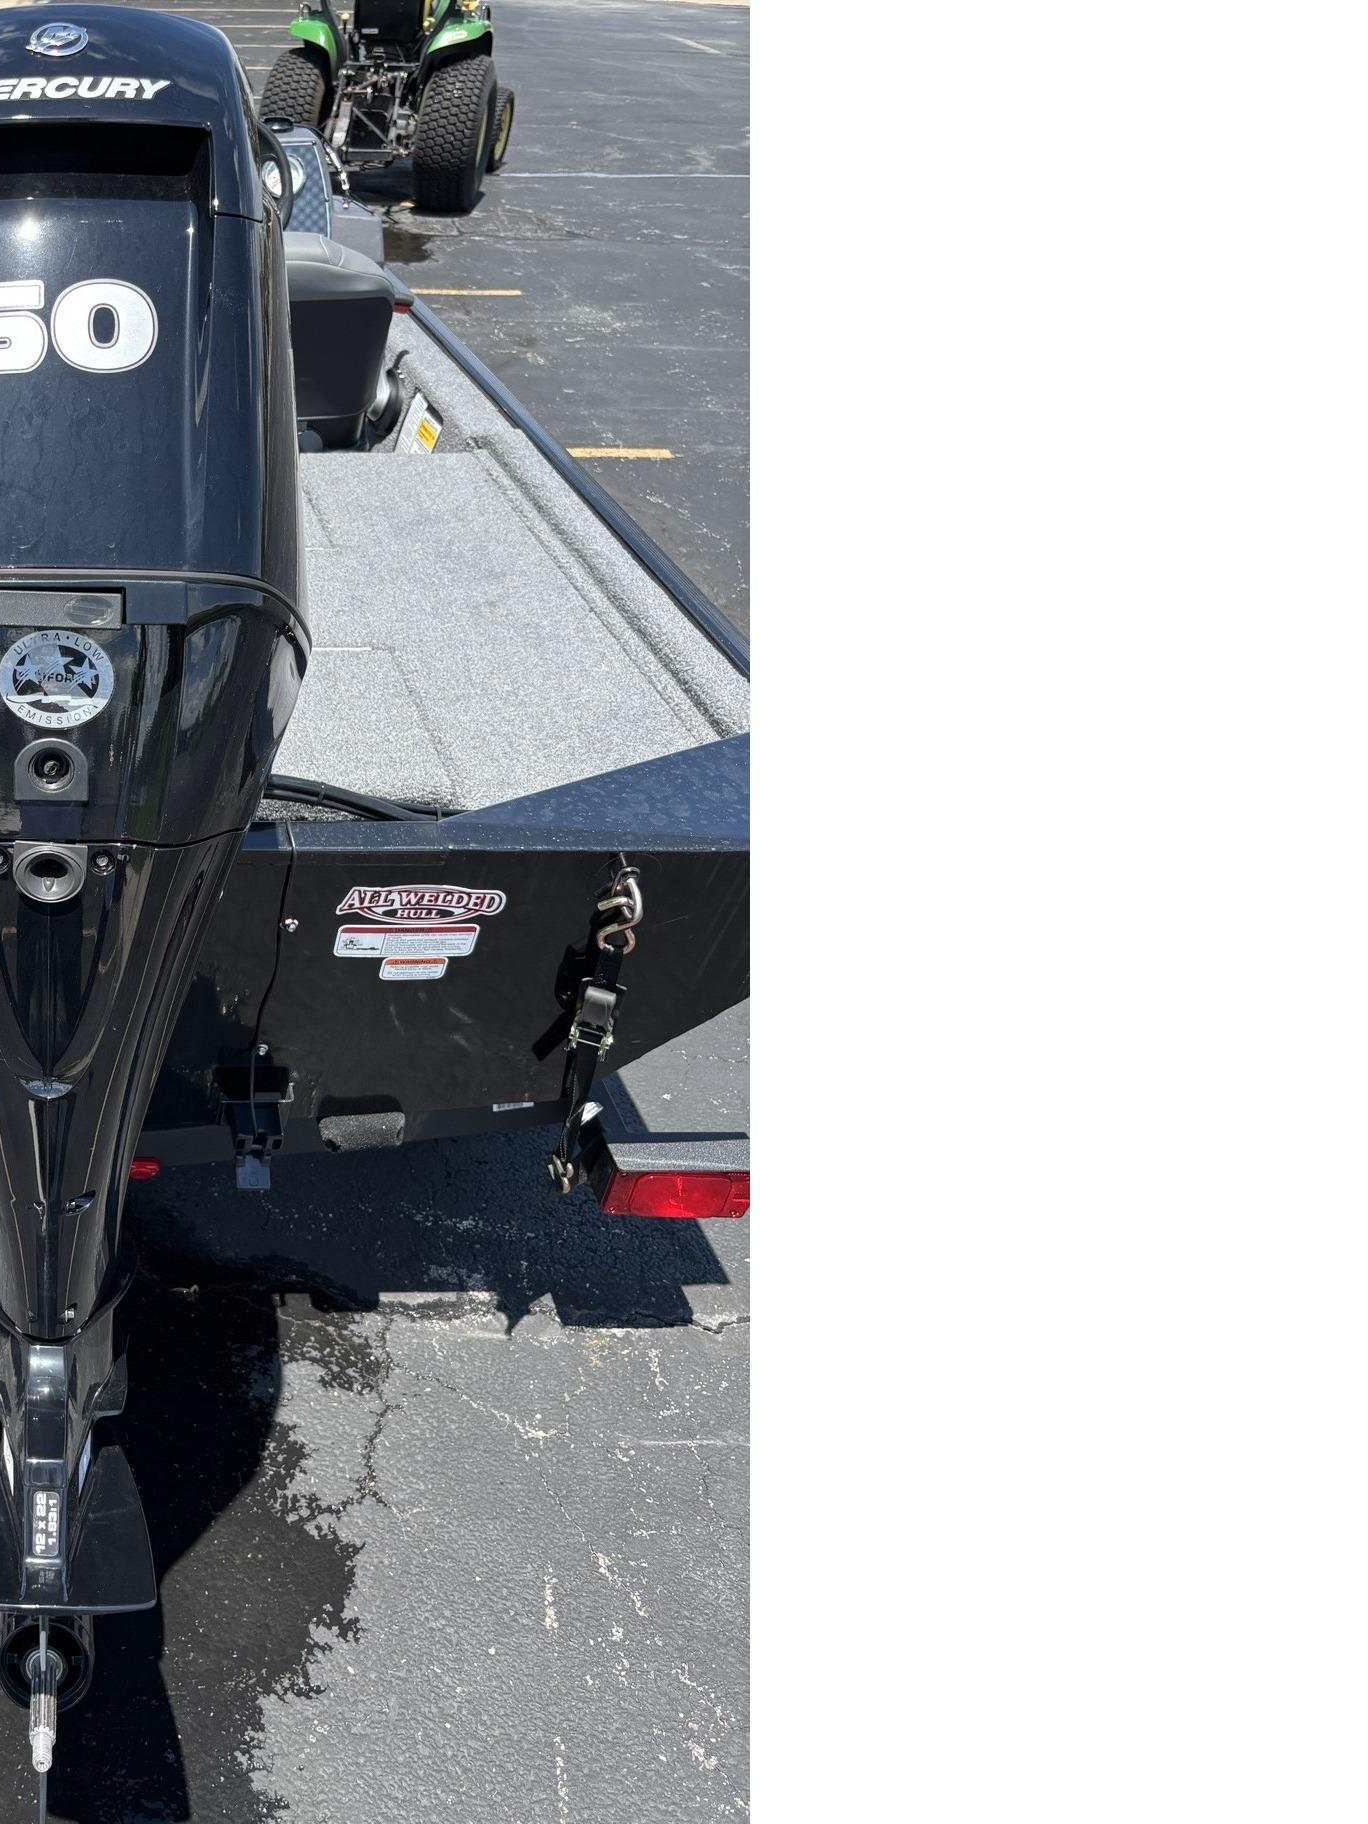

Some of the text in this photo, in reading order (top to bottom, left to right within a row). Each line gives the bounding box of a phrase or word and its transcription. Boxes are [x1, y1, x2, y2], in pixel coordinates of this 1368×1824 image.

[14, 632, 105, 662] ULRA LOW
[340, 888, 502, 912] ALL WELDED
[395, 909, 441, 919] HULL
[36, 1493, 47, 1517] 22
[47, 1499, 57, 1546] 1.83:1
[35, 1533, 46, 1554] 12
